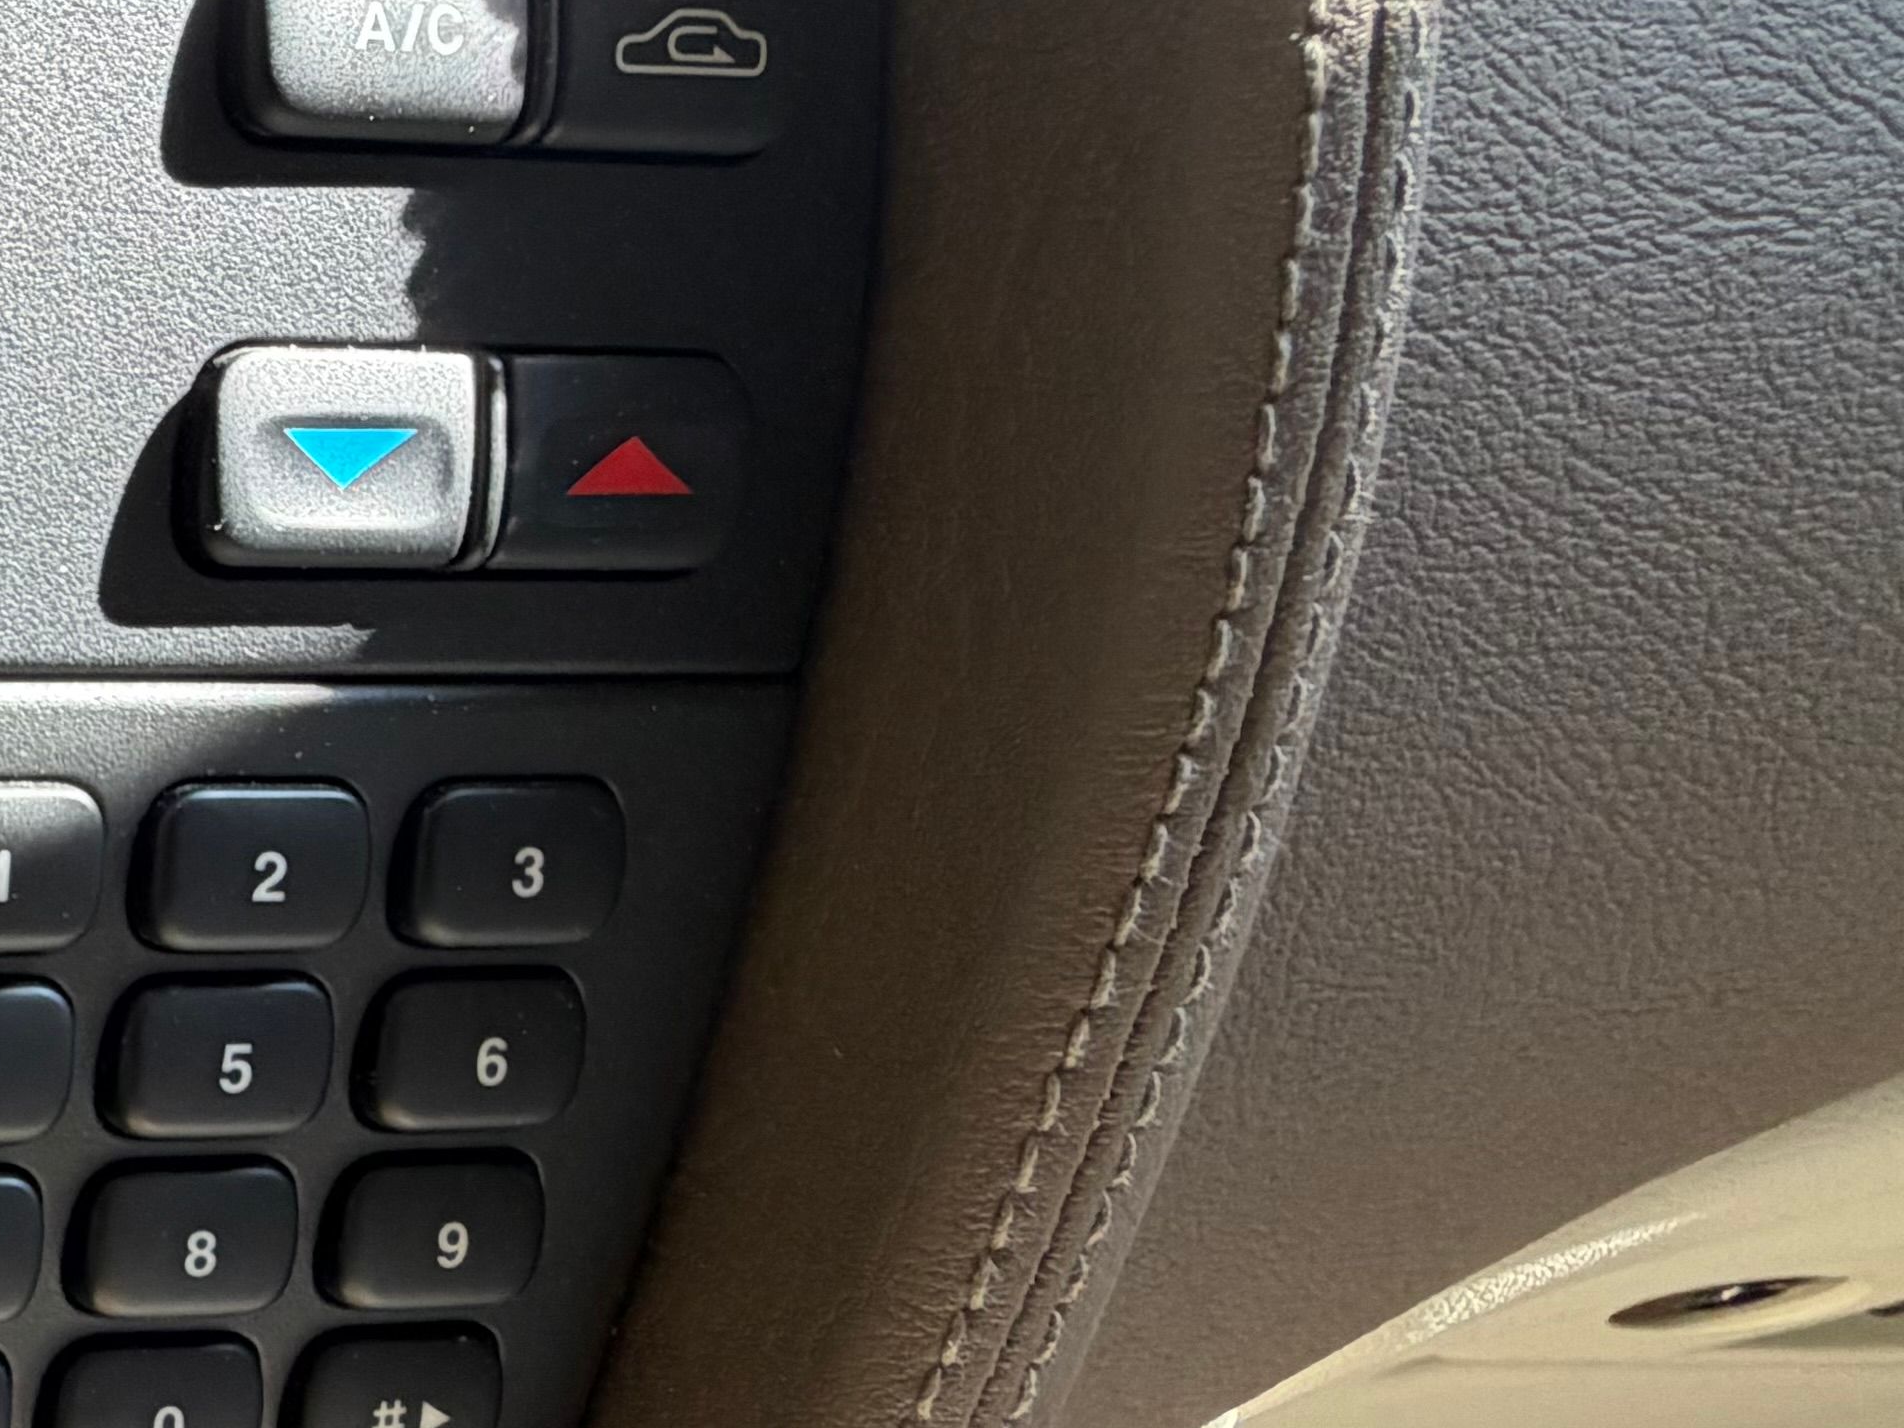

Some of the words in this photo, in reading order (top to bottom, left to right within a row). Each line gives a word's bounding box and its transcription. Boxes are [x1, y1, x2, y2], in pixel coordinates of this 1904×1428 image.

[354, 0, 466, 57] A/C
[251, 849, 289, 903] 2
[511, 845, 546, 899] 3
[218, 1042, 253, 1095] 5
[475, 1036, 509, 1088] 6
[183, 1229, 218, 1279] 8
[436, 1220, 470, 1270] 9
